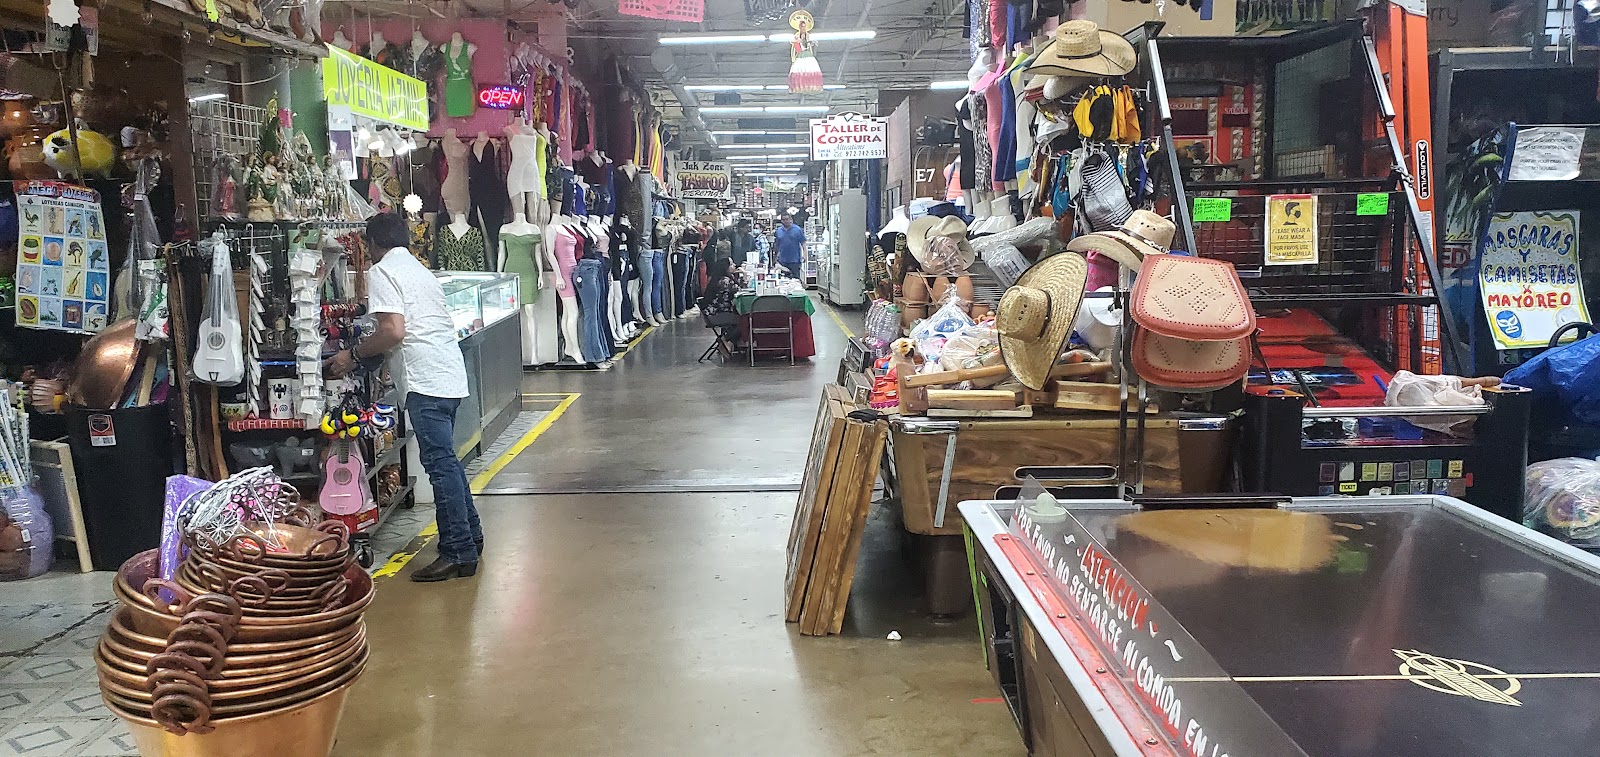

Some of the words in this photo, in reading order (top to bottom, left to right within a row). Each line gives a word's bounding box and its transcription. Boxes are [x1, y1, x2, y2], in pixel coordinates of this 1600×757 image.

[335, 57, 385, 114] JOYERIA
[386, 74, 421, 122] JAZMIN
[480, 90, 521, 105] OPEN
[822, 125, 868, 133] TALLER
[817, 134, 882, 144] COSTURA
[916, 168, 936, 183] E7
[1419, 150, 1427, 197] LOUISVILLE
[1482, 223, 1574, 256] MASCARAS
[1518, 248, 1531, 263] Y
[1484, 263, 1577, 285] CAMISETAS
[1018, 505, 1032, 538] POR
[1032, 524, 1055, 569] FAVOR
[1056, 557, 1070, 585] NO
[1070, 575, 1122, 653] SENTARSE
[1123, 640, 1138, 671] NI
[1137, 656, 1181, 730] COMIDA
[1185, 718, 1208, 757] EN
